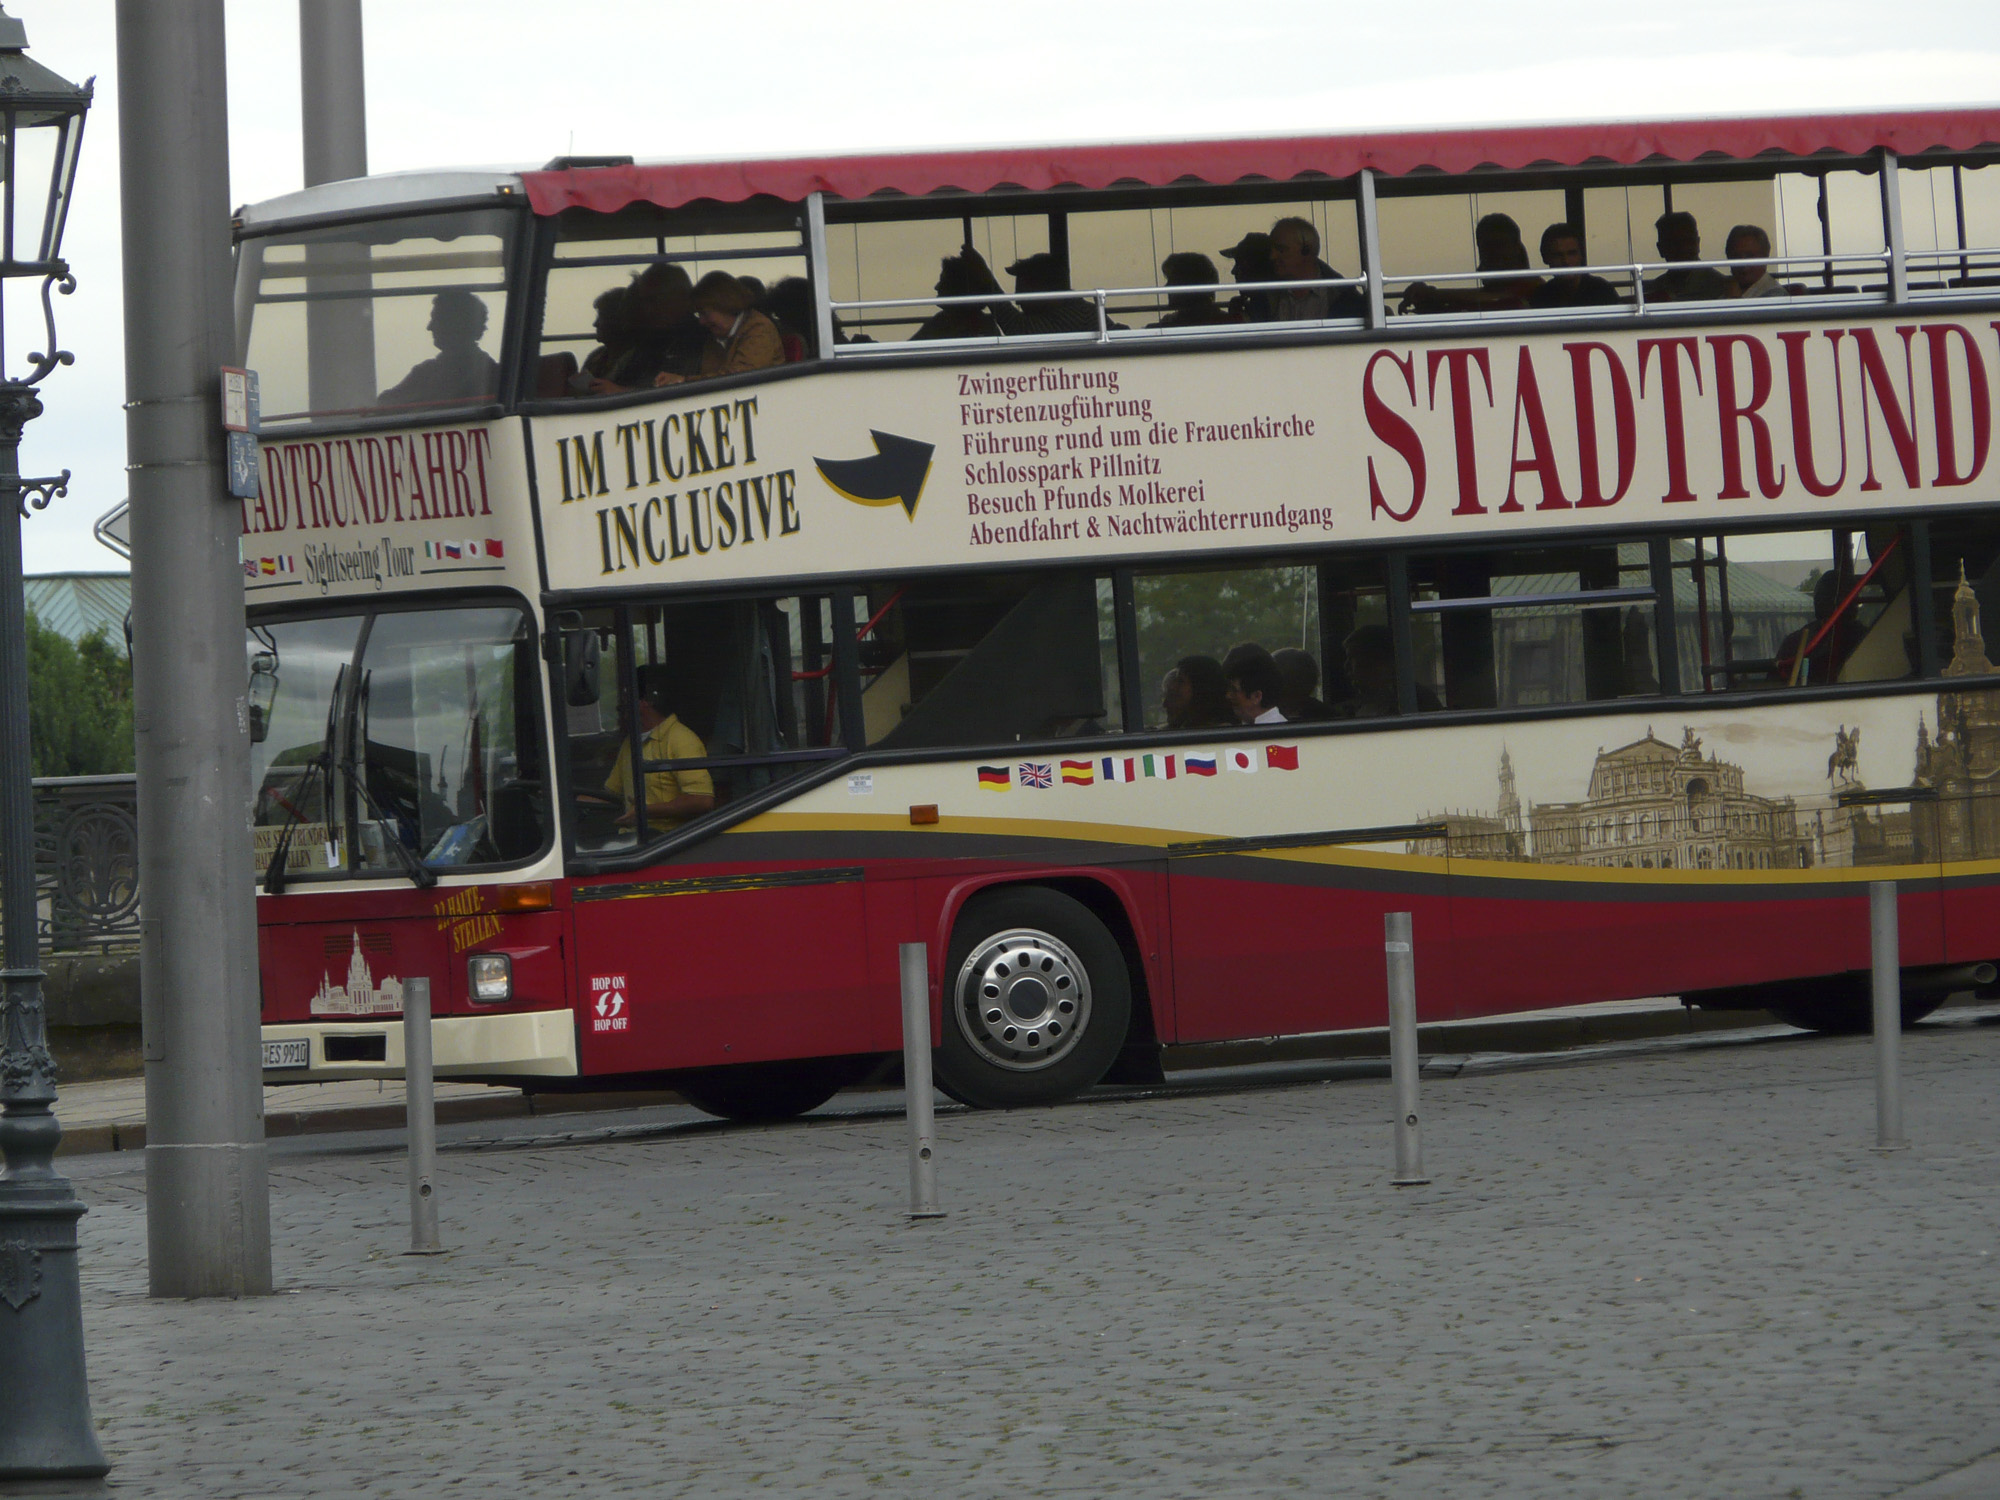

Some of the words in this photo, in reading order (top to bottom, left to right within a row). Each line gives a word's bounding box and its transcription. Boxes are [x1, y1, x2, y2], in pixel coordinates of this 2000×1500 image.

[958, 367, 1119, 400] Zwingerführung
[960, 396, 1153, 427] Fürstenzugführung
[1363, 321, 2000, 522] STADTRUND
[556, 430, 610, 505] IM
[616, 395, 758, 490] TICKET
[963, 431, 1049, 458] Führung
[1055, 425, 1103, 451] rund
[1110, 428, 1142, 447] um
[1148, 422, 1178, 445] die
[1185, 413, 1315, 443] Frauenkirche
[965, 457, 1084, 488] Schlosspark
[1090, 453, 1162, 479] Pillnitz
[967, 489, 1037, 515] Besuch
[1043, 484, 1113, 511] Pfunds
[1118, 479, 1205, 507] Molkerei
[596, 468, 801, 576] INCLUSIVE
[969, 516, 1080, 545] Abendfahrt
[1086, 515, 1102, 538] &
[1107, 503, 1333, 537] Nachtwächterrundgang
[305, 540, 383, 595] Sightseeing
[381, 537, 415, 577] Tour
[592, 976, 610, 990] HOP
[612, 976, 625, 989] ON
[594, 1018, 611, 1031] HOP
[612, 1017, 627, 1030] OFF
